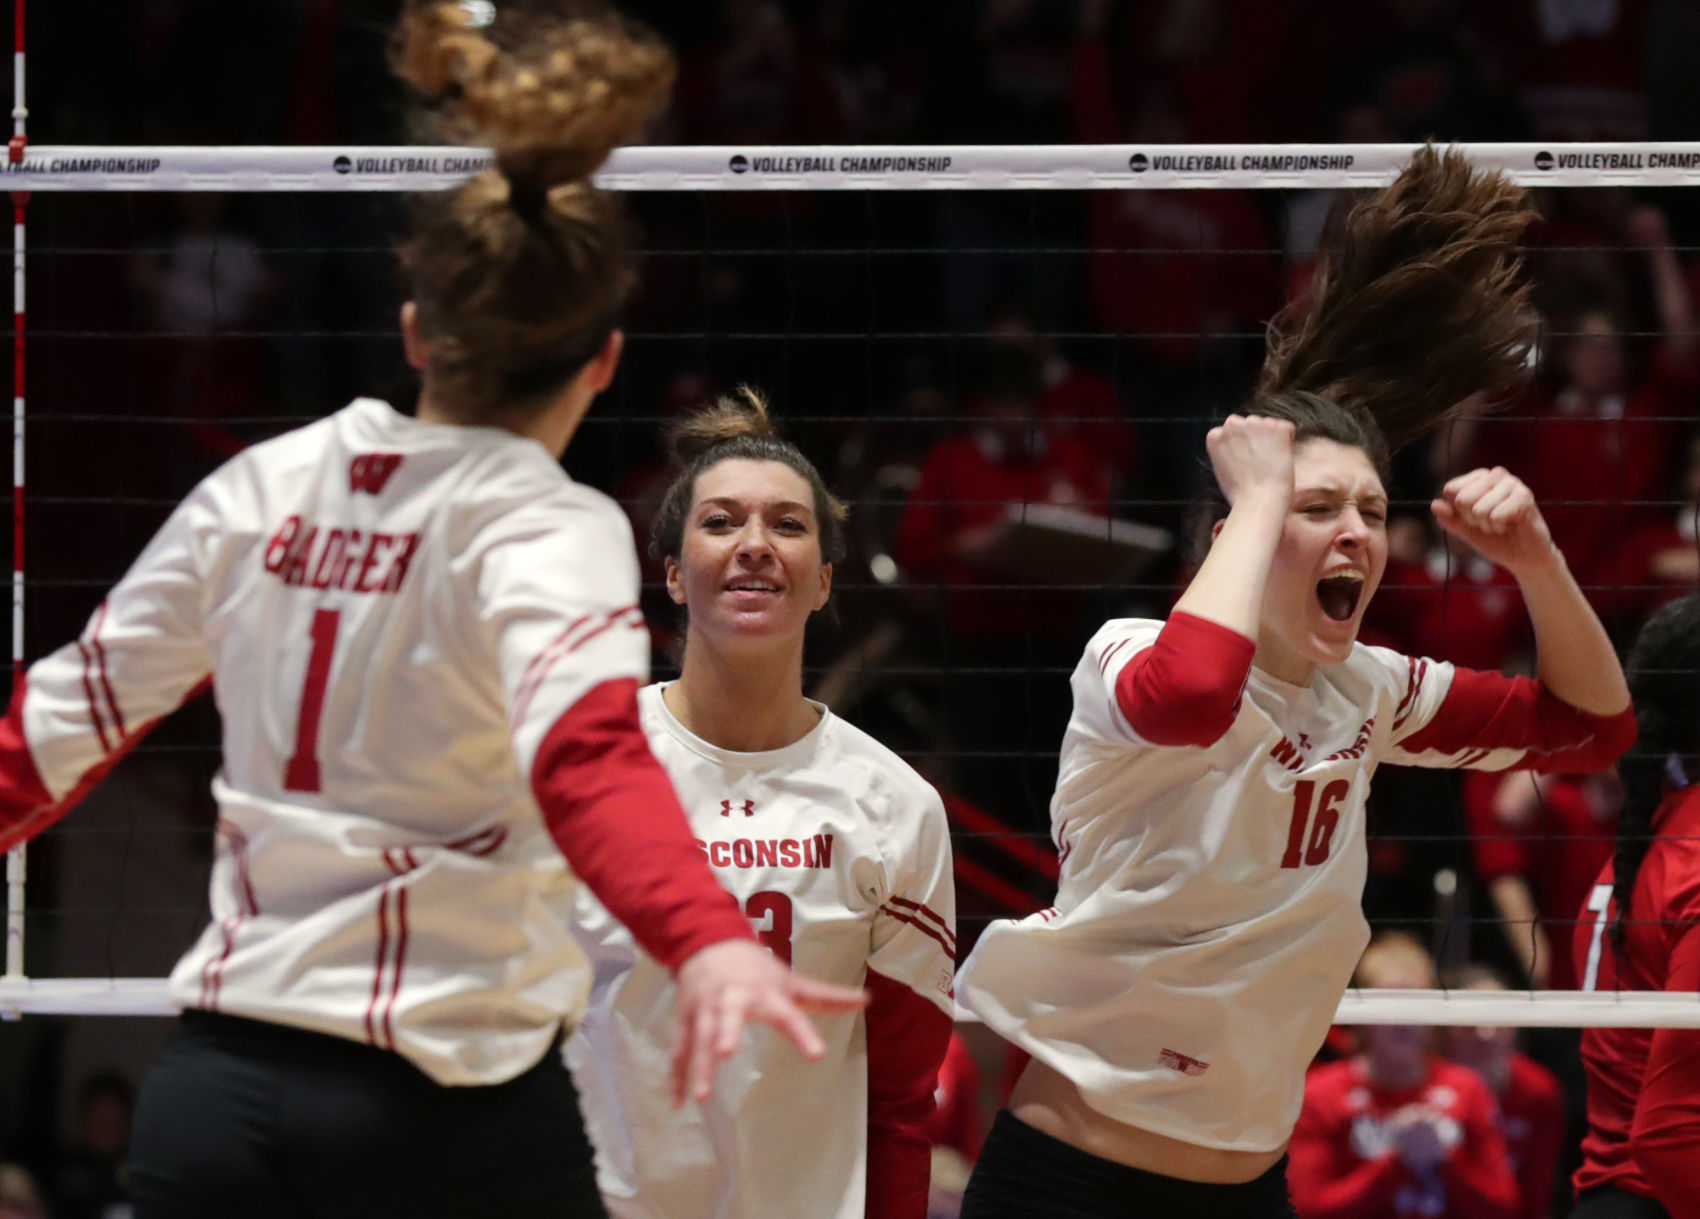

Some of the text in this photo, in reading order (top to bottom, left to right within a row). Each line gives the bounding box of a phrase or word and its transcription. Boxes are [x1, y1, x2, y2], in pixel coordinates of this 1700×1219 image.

[50, 158, 161, 174] CHAMPIONSHIP
[356, 158, 437, 174] VOLLEYBALL
[753, 156, 835, 172] VOLLEYBALL
[840, 156, 951, 172] CHAMPIONSHIP
[1152, 155, 1236, 171] VOLLEYBALL
[1241, 155, 1354, 170] CHAMPIONSHIP
[1558, 153, 1644, 169] VOLLEYBALL
[1648, 153, 1700, 168] CHAMP
[349, 453, 405, 496] W
[283, 608, 341, 793] 1
[1280, 778, 1350, 869] 16
[727, 890, 793, 972] 3
